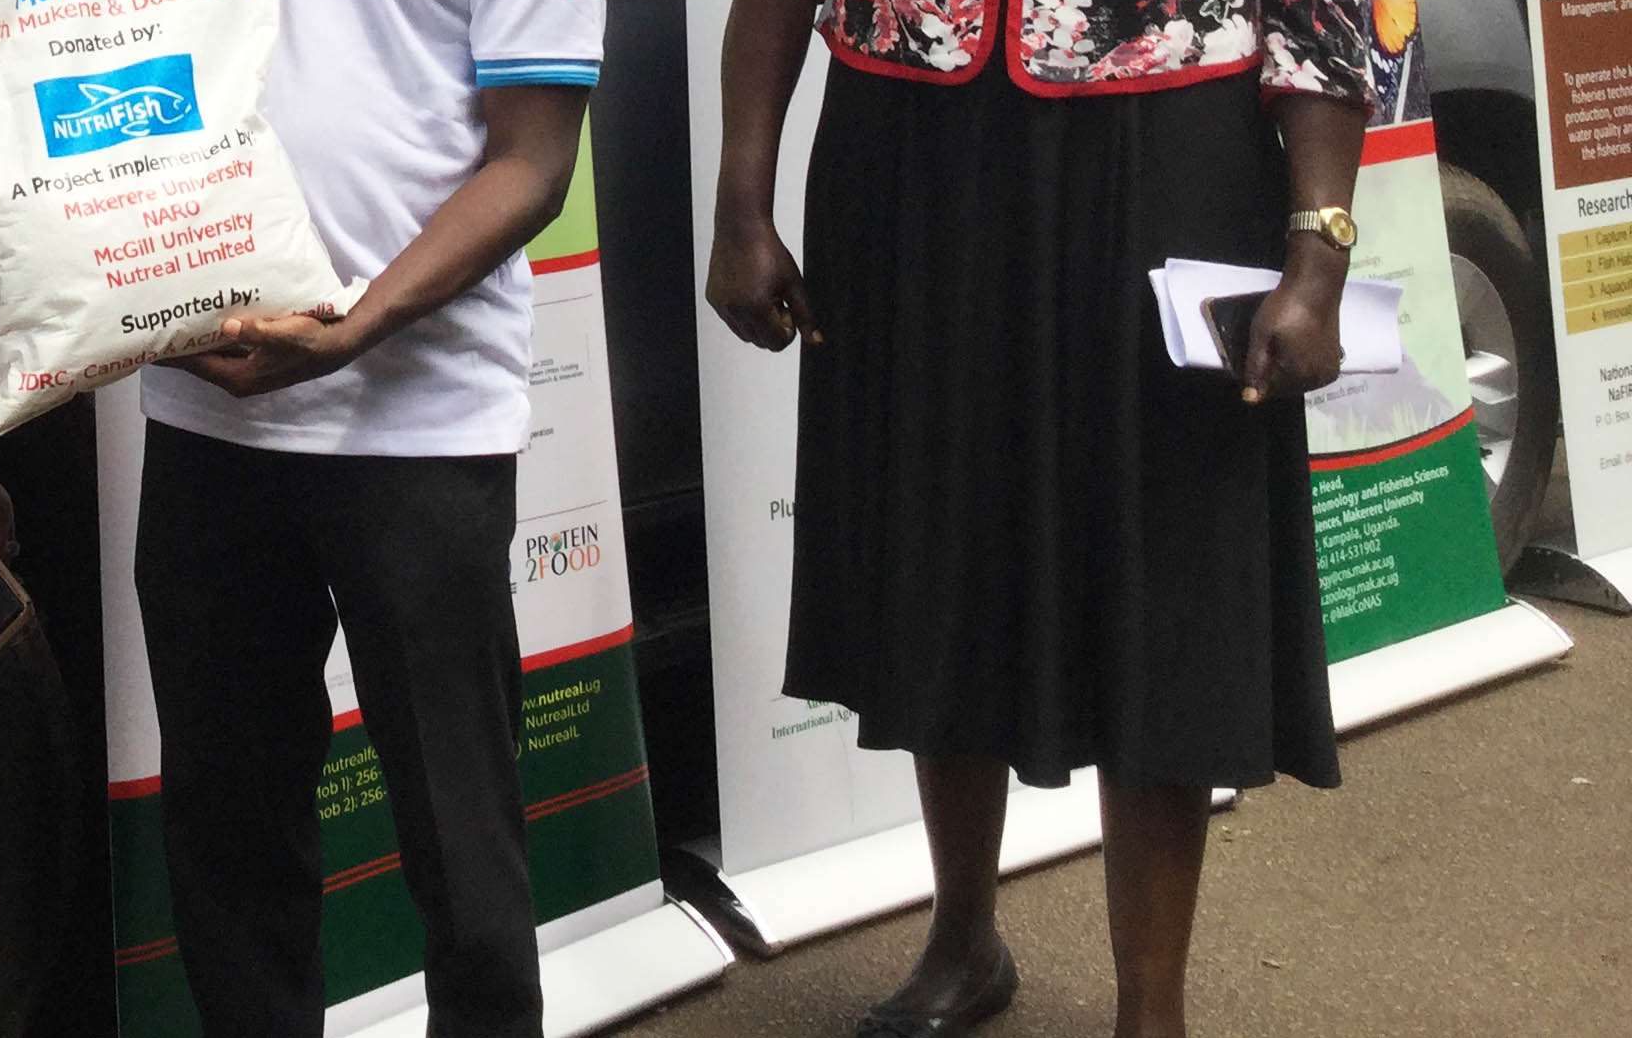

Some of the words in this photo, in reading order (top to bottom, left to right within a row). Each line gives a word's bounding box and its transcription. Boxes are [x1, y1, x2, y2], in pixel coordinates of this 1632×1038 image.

[18, 0, 102, 34] Mukene
[1561, 0, 1620, 18] Management,
[48, 30, 125, 57] Donated
[130, 22, 163, 43] by:
[1563, 72, 1574, 87] To
[1574, 69, 1612, 88] generate
[1613, 68, 1626, 81] the
[1571, 87, 1607, 104] fisheries
[53, 95, 163, 140] NUTRIFish
[1564, 106, 1613, 127] production,
[1568, 125, 1593, 144] water
[1594, 122, 1622, 140] quality
[11, 182, 27, 200] A
[31, 167, 105, 194] Project
[109, 134, 232, 179] implemented
[1581, 144, 1596, 161] the
[1597, 140, 1631, 157] fisheries
[63, 188, 158, 220] Makerere
[161, 159, 254, 197] University
[142, 200, 201, 229] NARO
[93, 236, 156, 266] McGill
[160, 212, 254, 251] University
[106, 256, 181, 289] Nutreal
[186, 234, 256, 269] Limited
[120, 288, 225, 334] Supported
[230, 285, 261, 307] by:
[18, 369, 76, 392] IDRC,
[83, 348, 158, 380] Canada
[1319, 475, 1344, 495] Head,
[1361, 483, 1379, 501] and
[1379, 474, 1414, 495] Fisheries
[1414, 465, 1449, 484] Sciences
[1342, 503, 1383, 524] Makerere
[1383, 490, 1424, 512] University
[1322, 527, 1362, 549] Kampala,
[1363, 514, 1400, 538] Uganda.
[525, 542, 601, 583] 2FOOD
[1329, 538, 1381, 564] 414-531902
[525, 699, 591, 731] NutrealLtd
[771, 709, 833, 740] International
[528, 725, 581, 752] NutrealL
